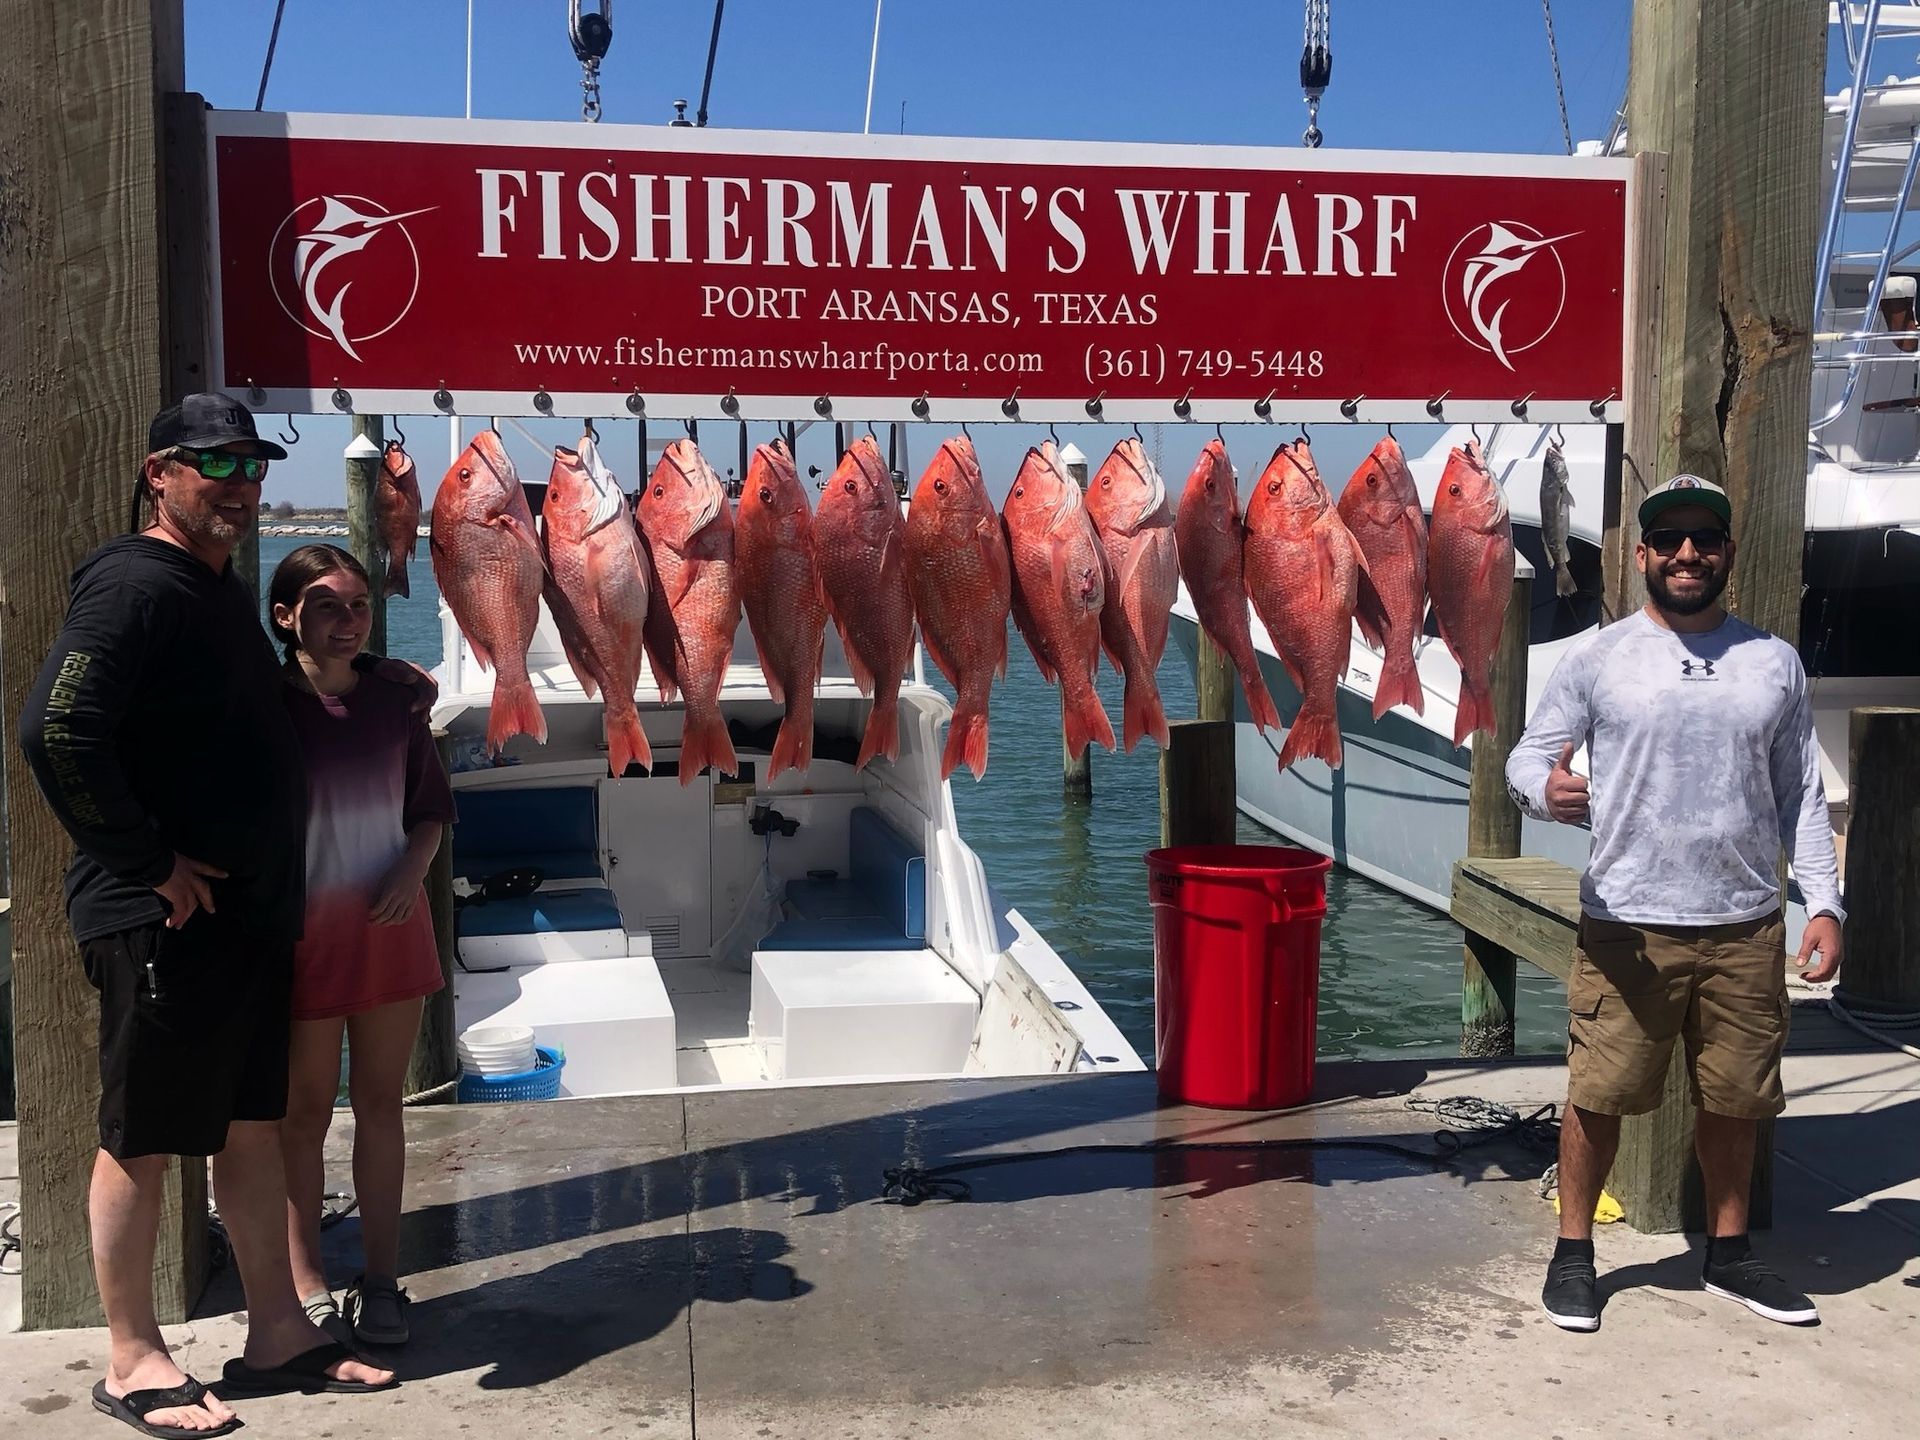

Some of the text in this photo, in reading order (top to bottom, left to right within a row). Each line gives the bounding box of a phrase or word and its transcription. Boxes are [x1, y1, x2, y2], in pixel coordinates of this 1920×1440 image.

[475, 168, 1417, 278] FISHERMAN'S WHARF
[702, 286, 1159, 329] PORT ARANSAS, TEXAS
[514, 337, 1325, 385] www.fishermanswharfporta.com (361) 749-5448
